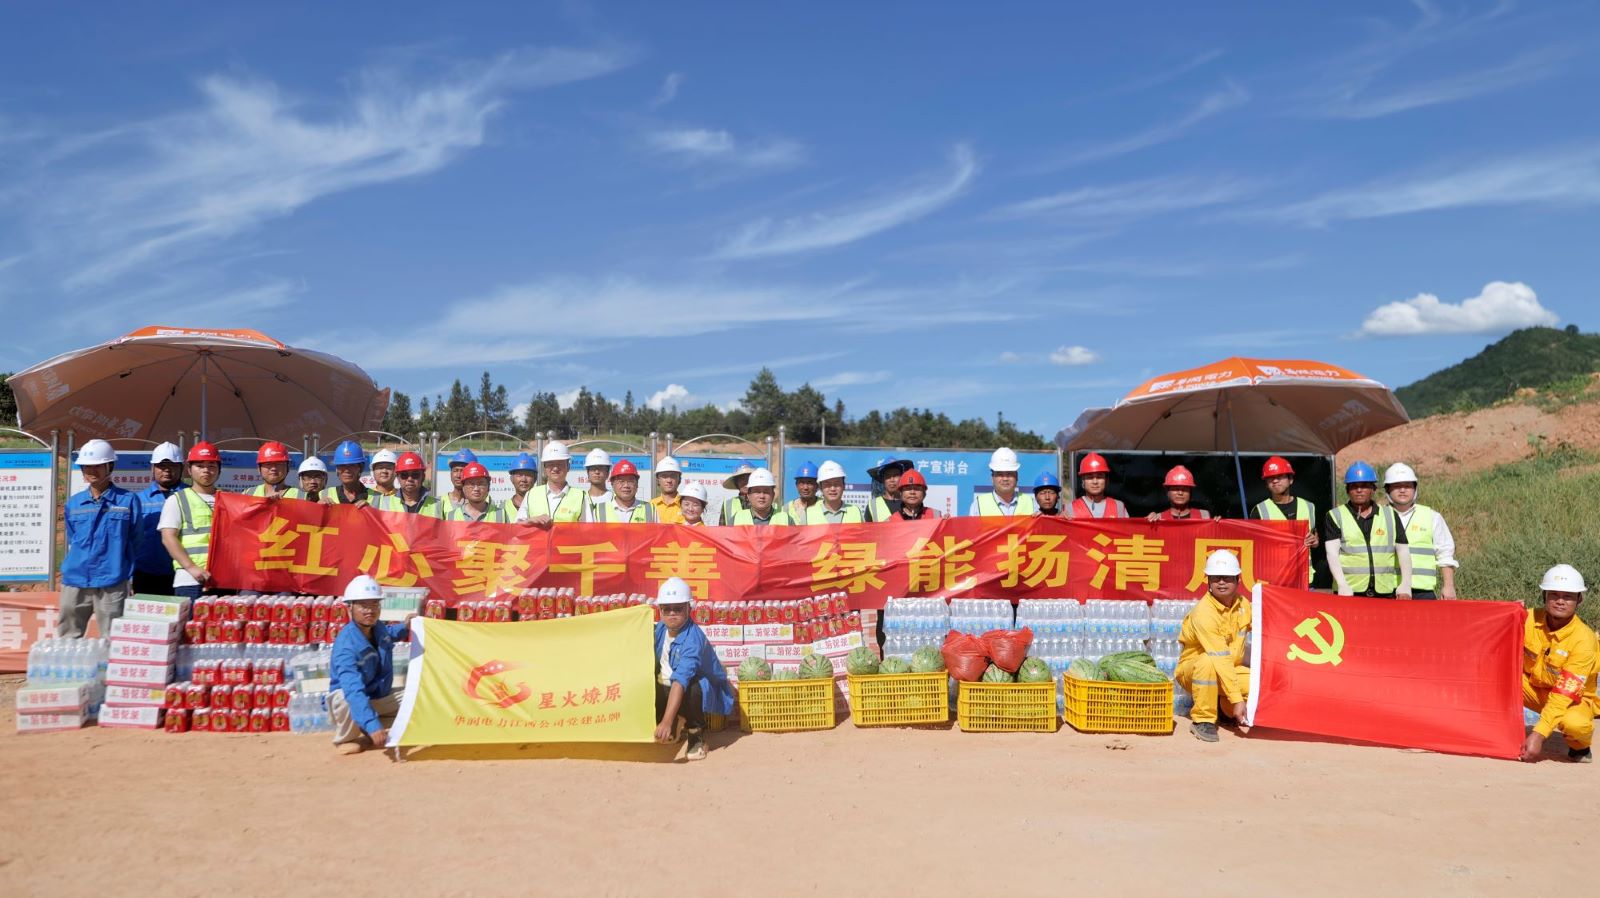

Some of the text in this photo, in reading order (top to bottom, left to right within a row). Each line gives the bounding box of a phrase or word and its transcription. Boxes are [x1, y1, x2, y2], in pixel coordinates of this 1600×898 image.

[254, 516, 1269, 600] 红心聚千善 绿能扬清风
[538, 683, 622, 710] 星火燎原
[453, 711, 621, 729] 华润电力江西公司党建品牌
